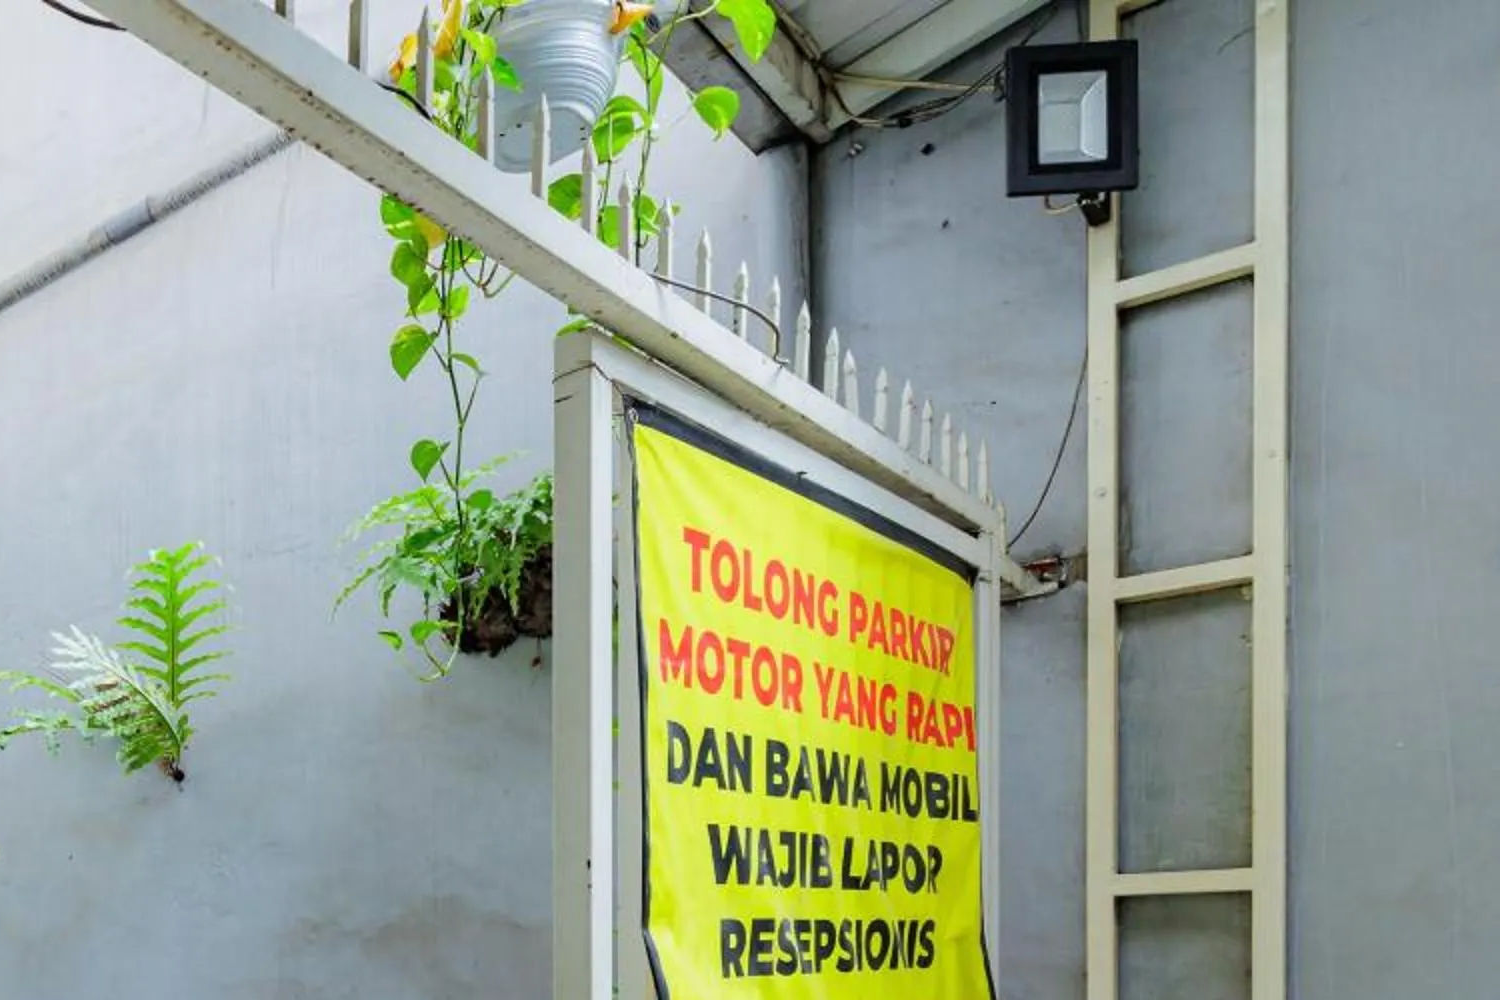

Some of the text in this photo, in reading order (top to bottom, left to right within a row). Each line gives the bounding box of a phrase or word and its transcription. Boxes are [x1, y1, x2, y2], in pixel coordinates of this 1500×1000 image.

[683, 527, 954, 676] TOLONG PARKIR
[659, 619, 975, 752] MOTOR YANG RAPI
[667, 720, 978, 821] DAN BAWA MOBIL
[707, 823, 943, 893] WAJIB LAPOR
[720, 918, 935, 978] RESEPSIONIS
